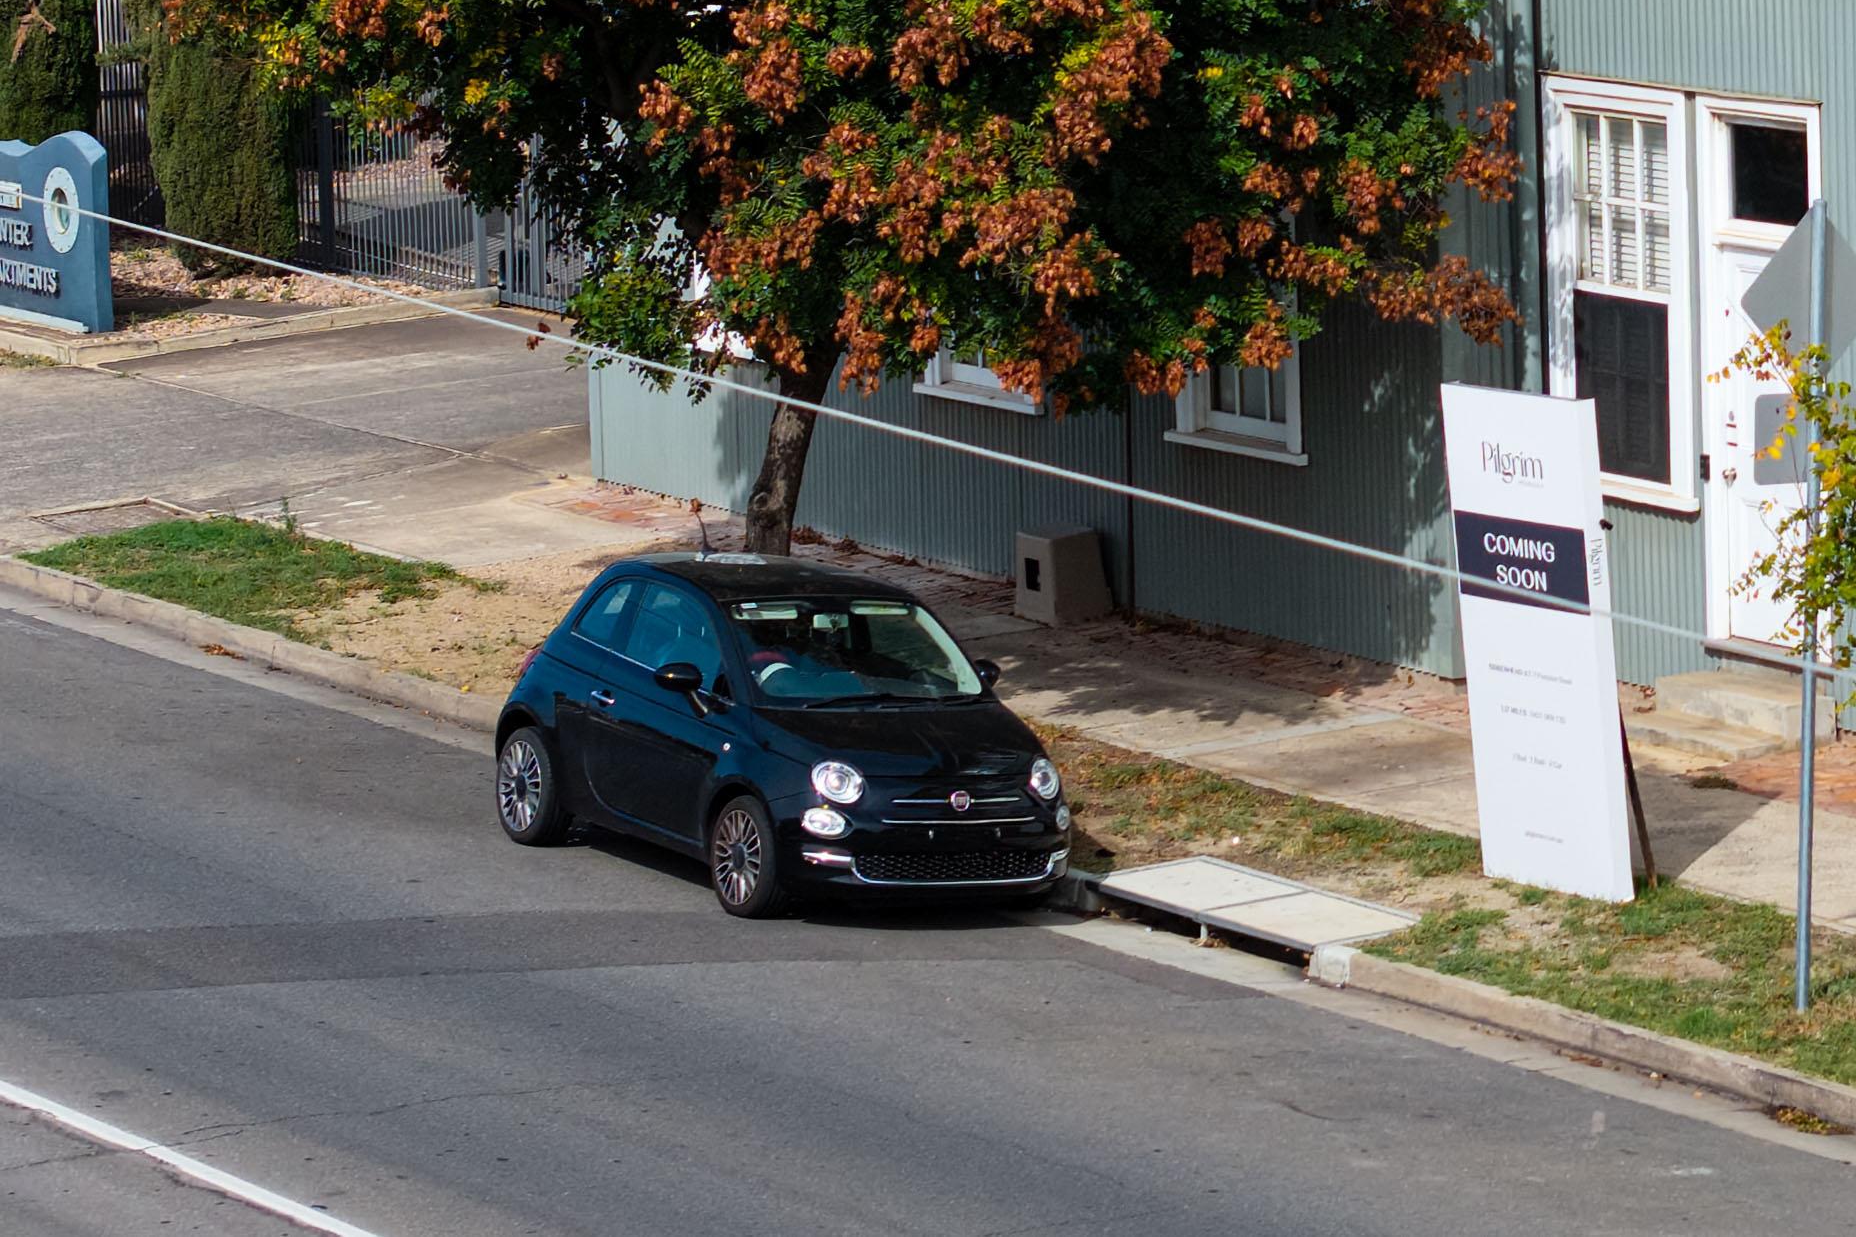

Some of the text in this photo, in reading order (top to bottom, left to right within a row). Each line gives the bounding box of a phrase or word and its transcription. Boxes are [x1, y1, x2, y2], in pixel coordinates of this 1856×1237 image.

[1481, 440, 1544, 484] Pilgrim
[1483, 532, 1556, 563] COMING
[1496, 564, 1548, 592] SOON
